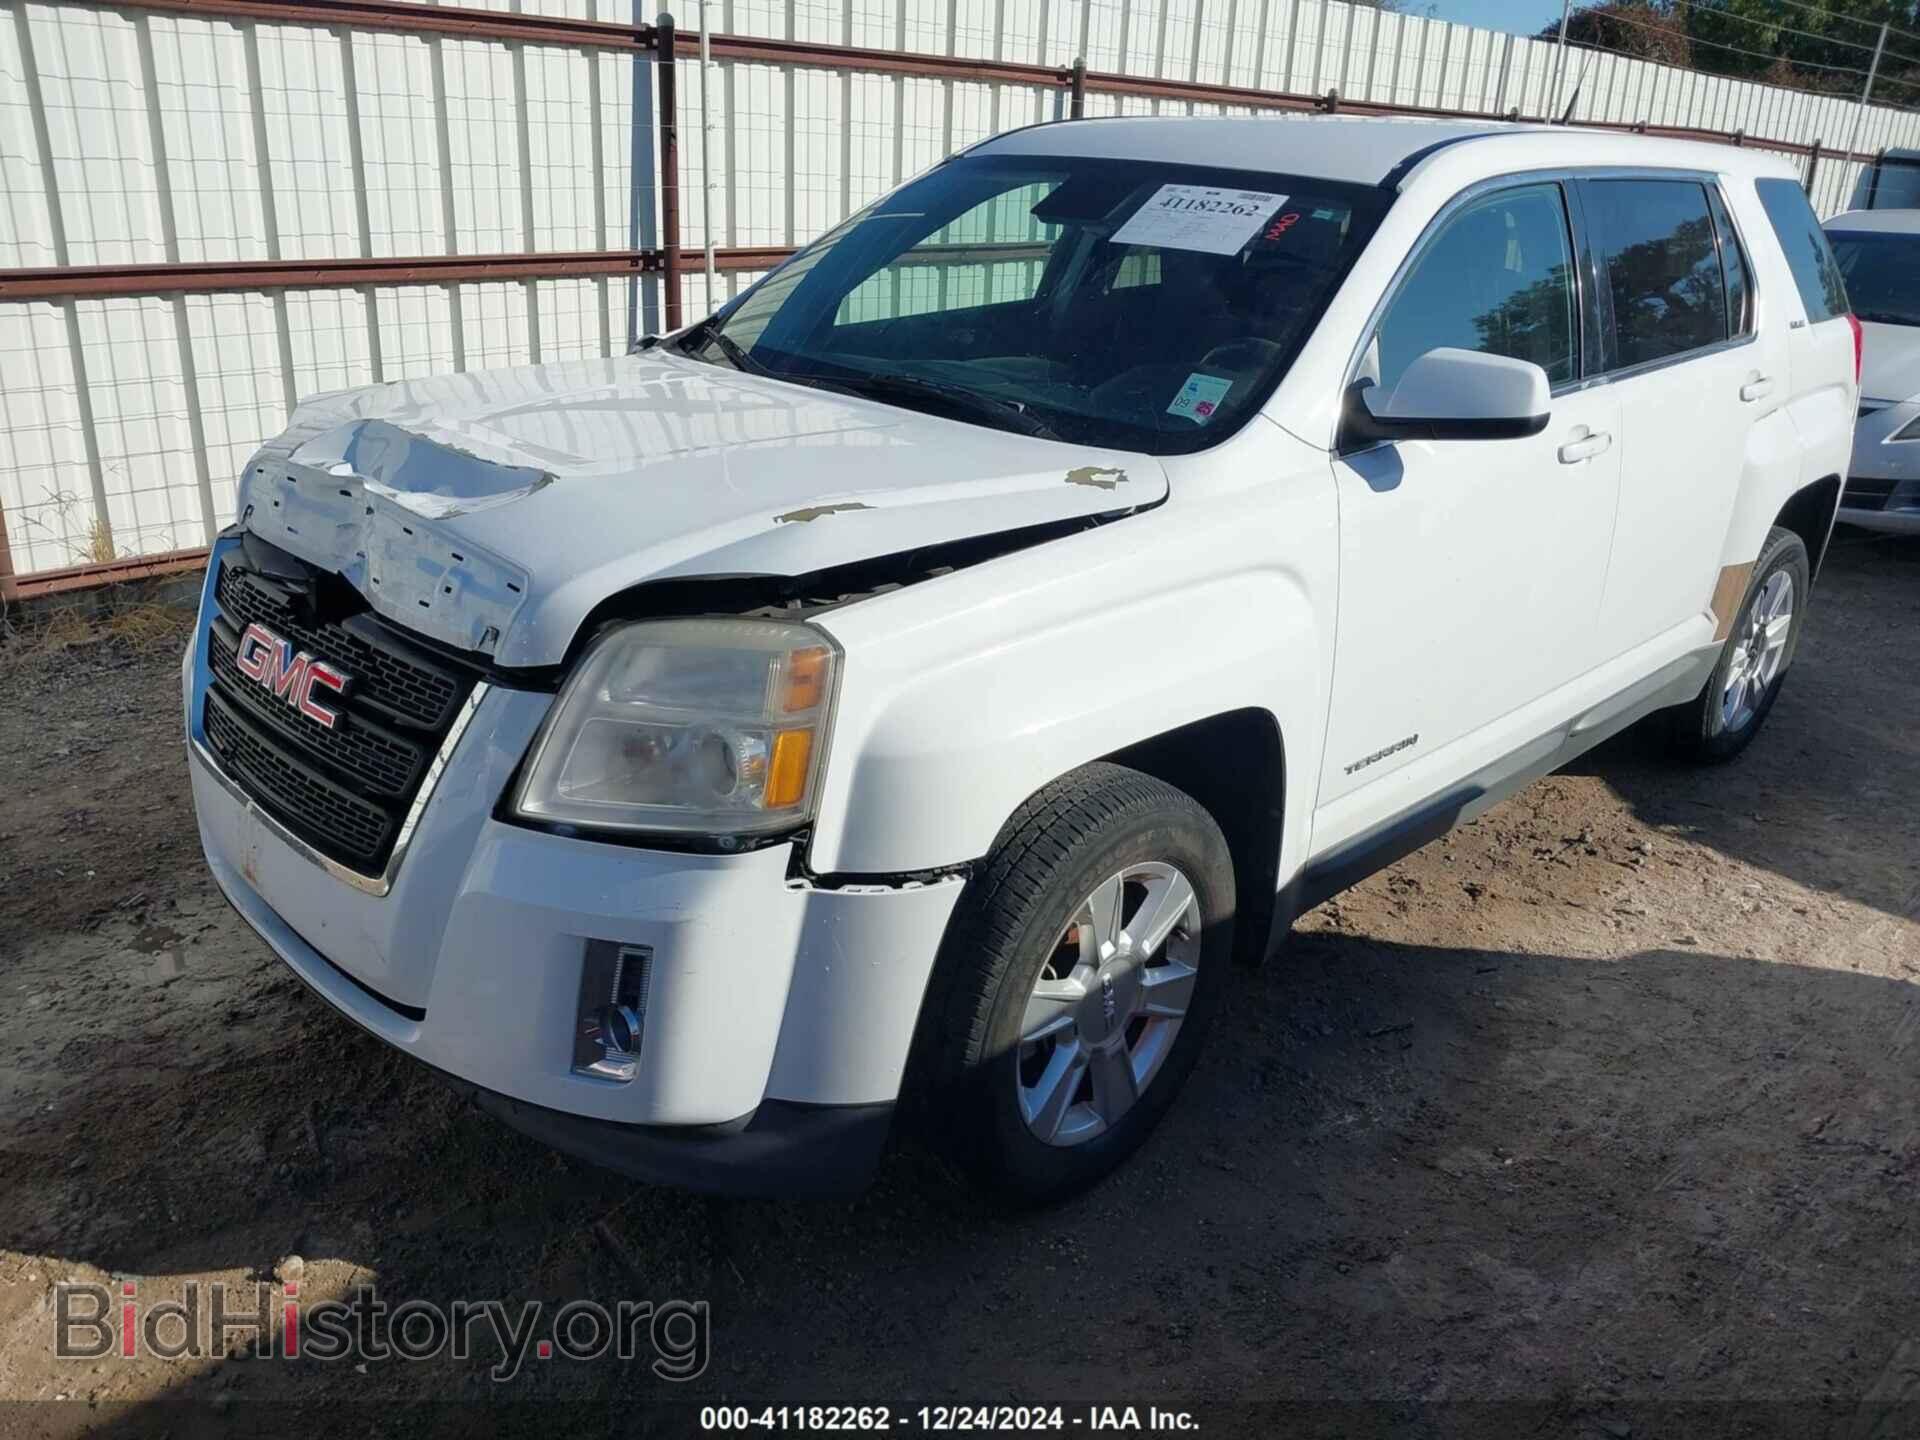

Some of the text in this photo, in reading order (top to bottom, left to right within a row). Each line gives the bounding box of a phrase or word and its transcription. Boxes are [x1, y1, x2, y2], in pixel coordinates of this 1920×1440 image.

[1160, 197, 1259, 216] 41182262
[237, 623, 352, 729] GMC
[1343, 733, 1419, 775] TERRAIN
